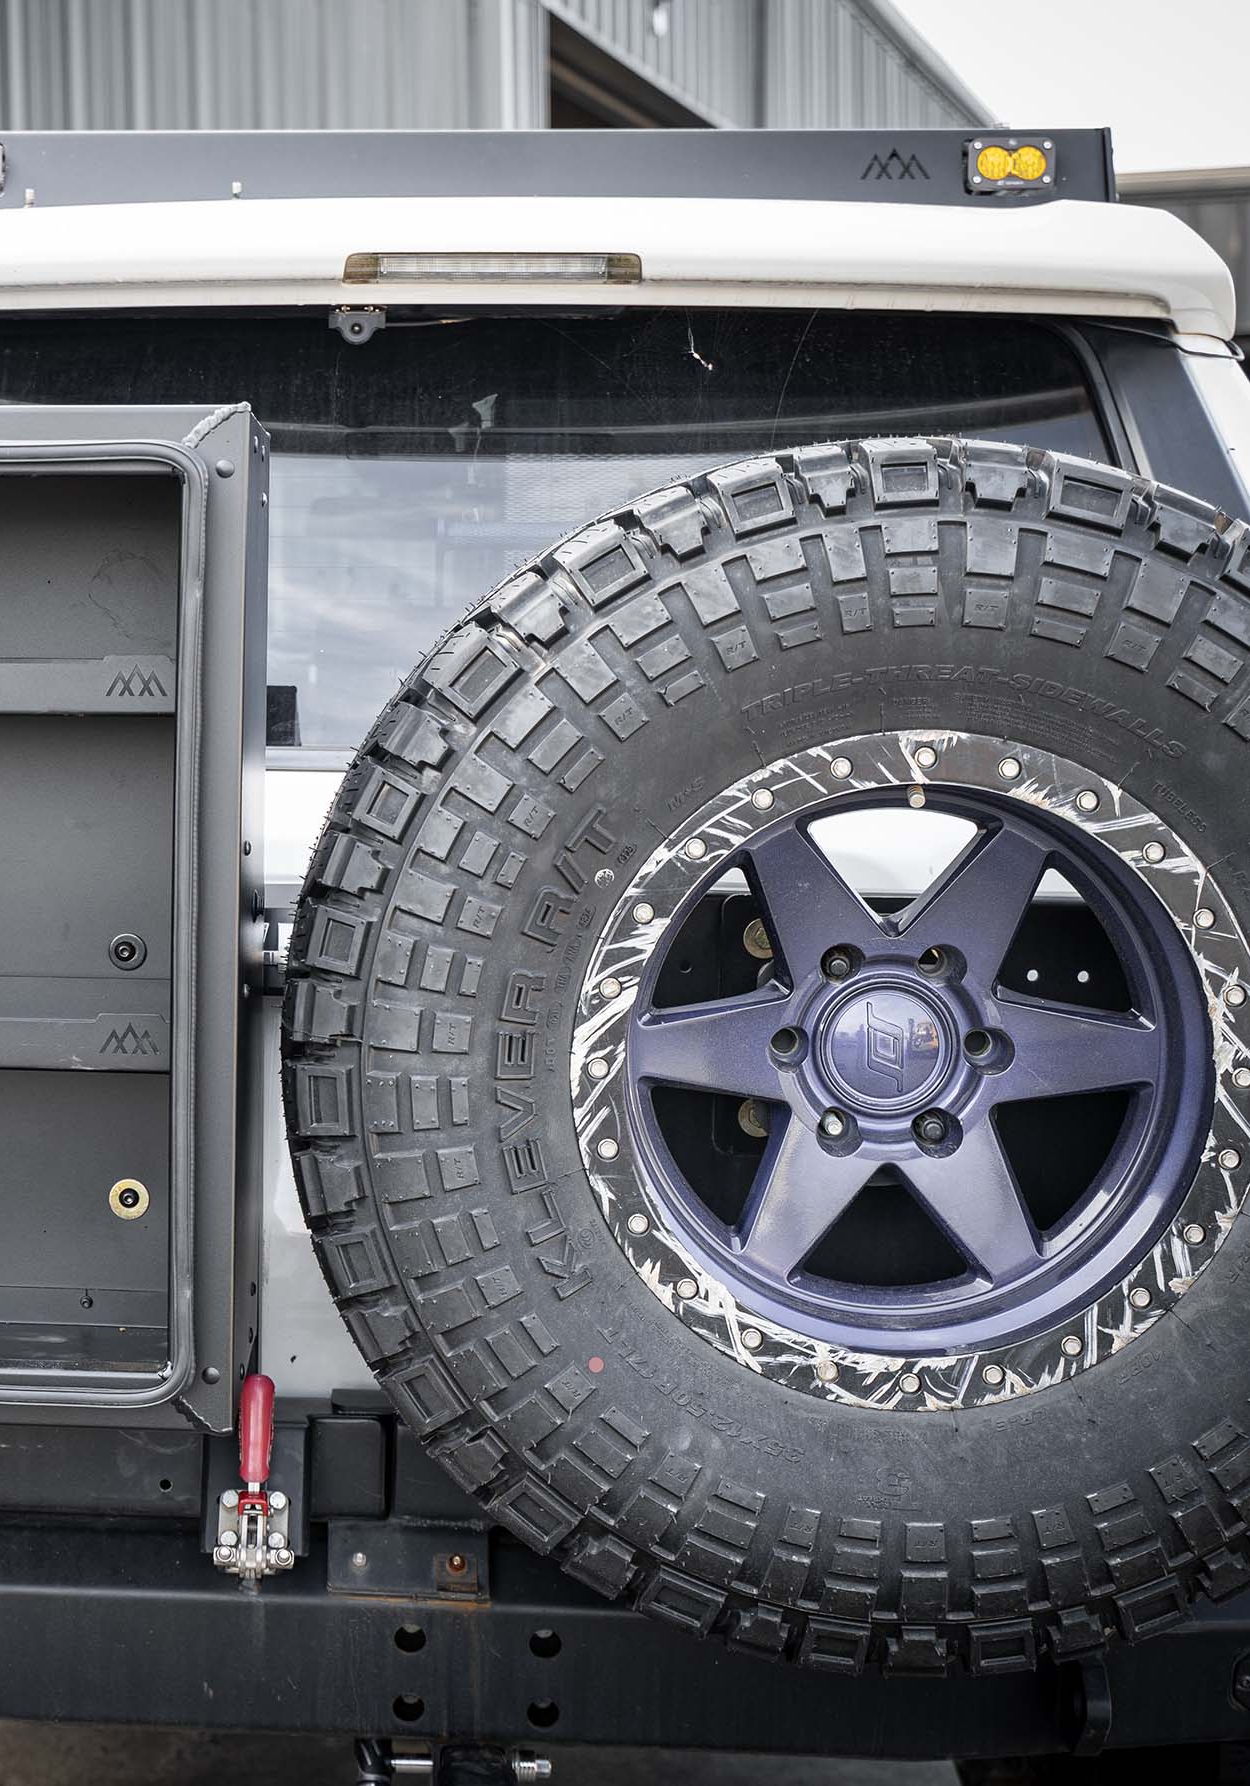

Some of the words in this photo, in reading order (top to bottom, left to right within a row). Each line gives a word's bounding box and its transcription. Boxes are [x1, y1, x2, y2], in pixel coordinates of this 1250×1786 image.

[522, 804, 617, 948] R/T
[1152, 781, 1208, 834] TUBELESS
[494, 968, 592, 1301] KLEVER
